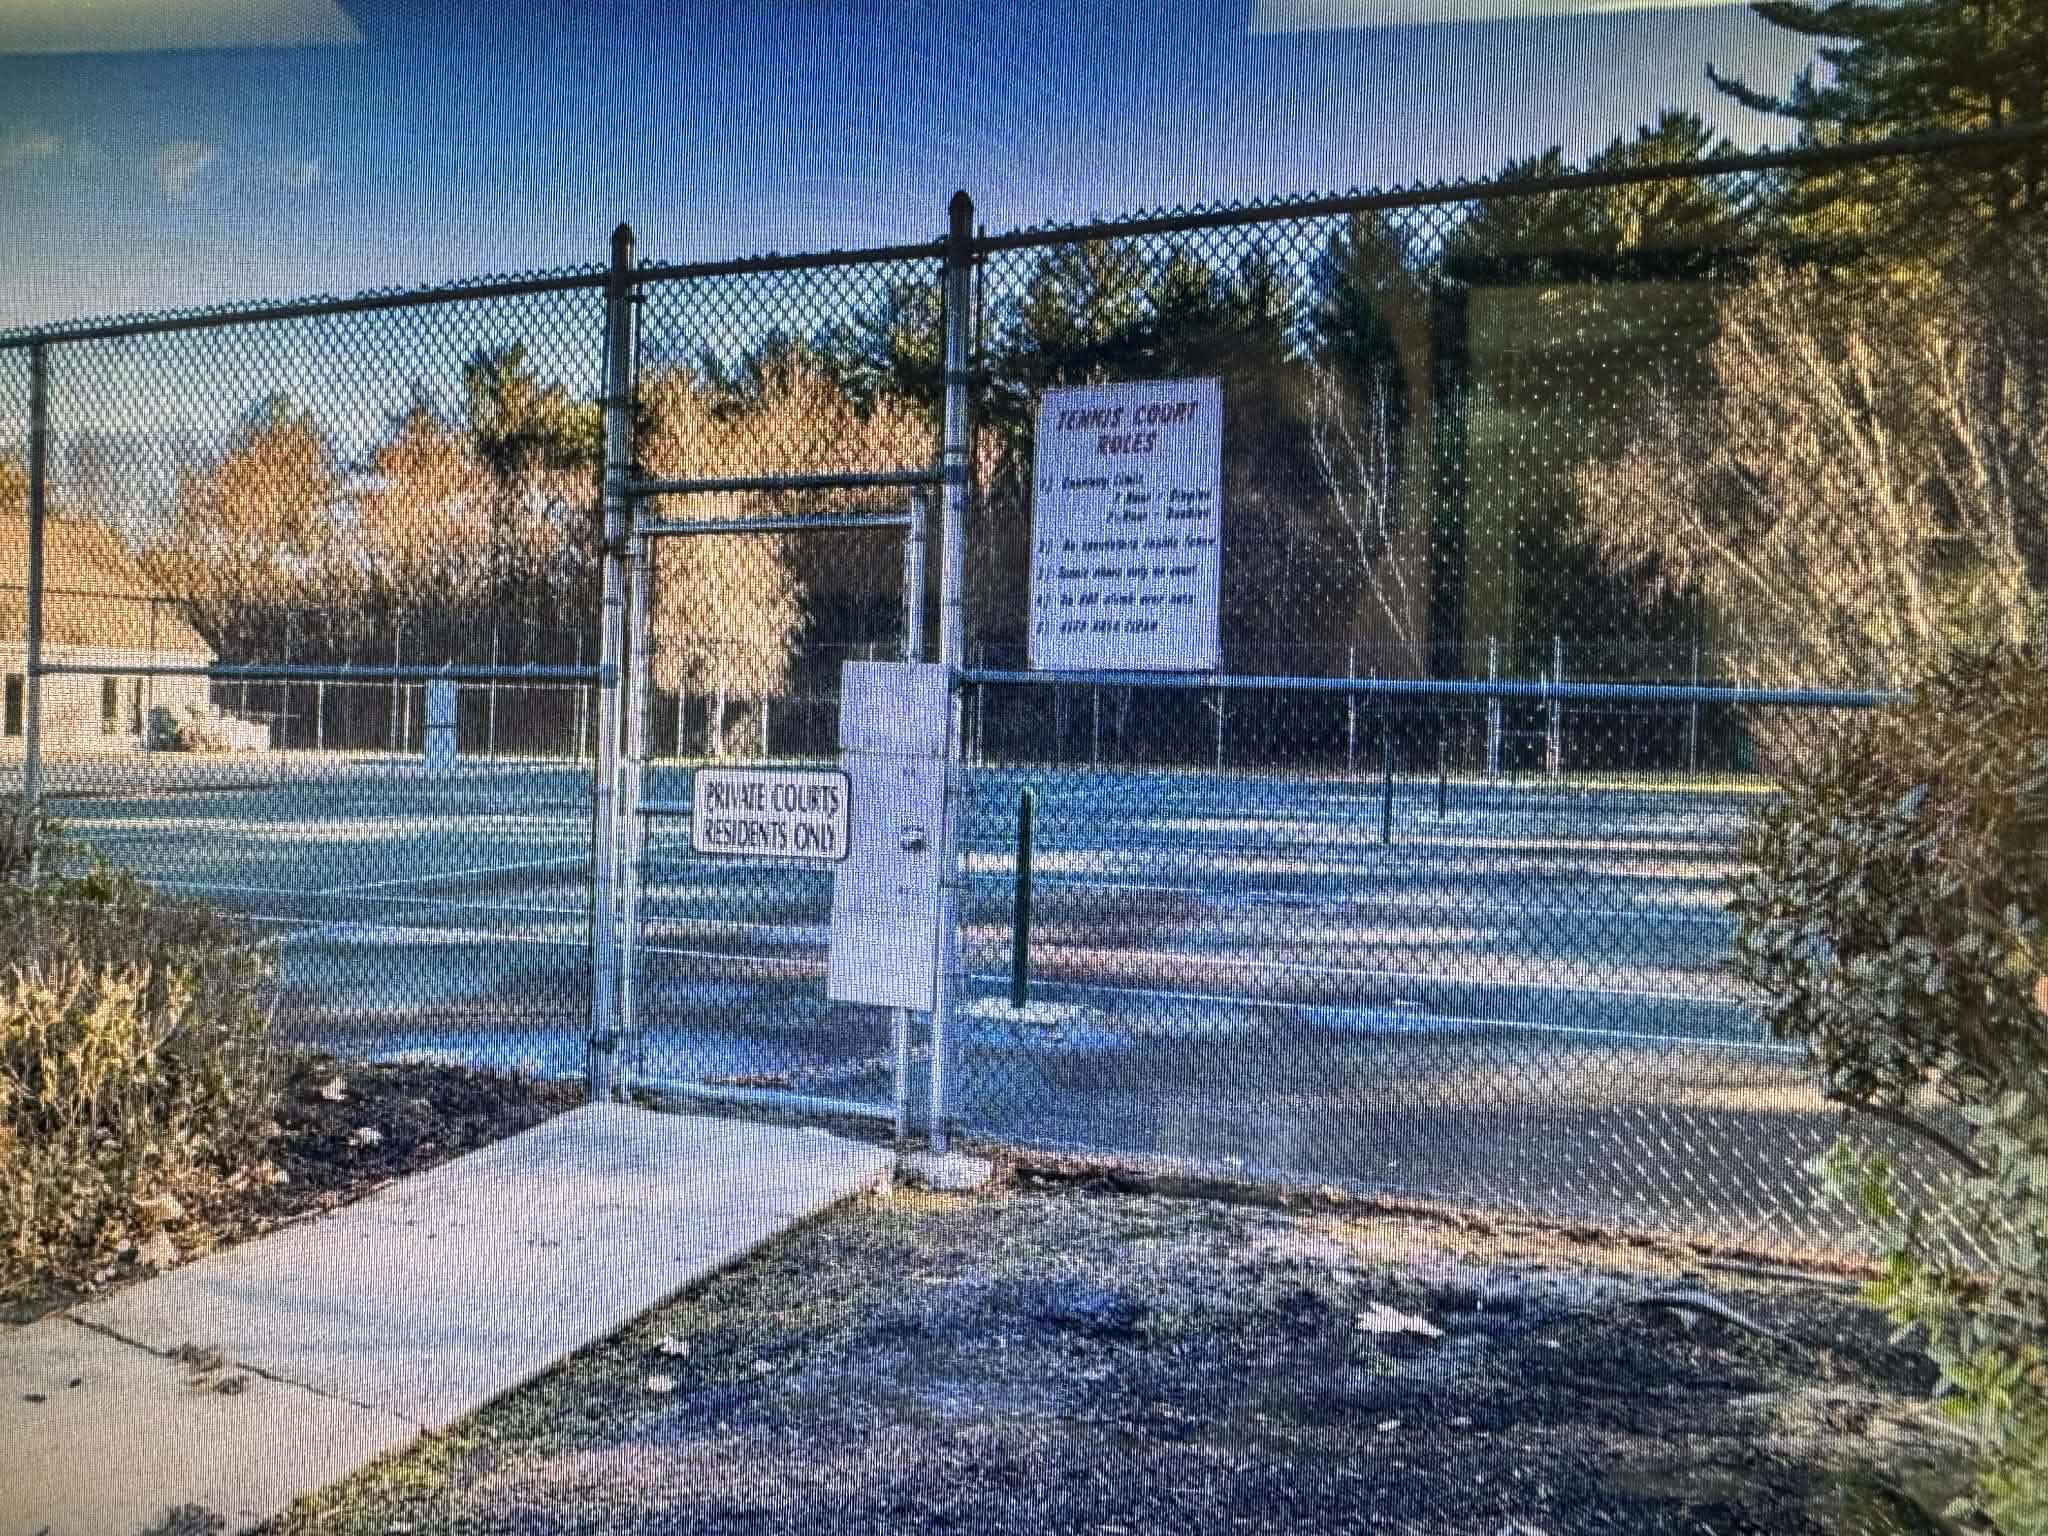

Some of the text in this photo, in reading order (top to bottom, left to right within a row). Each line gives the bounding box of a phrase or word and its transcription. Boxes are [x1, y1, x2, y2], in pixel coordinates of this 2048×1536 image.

[1057, 401, 1199, 431] TENNIS COURT
[1096, 431, 1158, 455] RULES
[705, 780, 839, 815] PRIVATE COURTS
[704, 819, 835, 852] RESIDENTS ONLY
